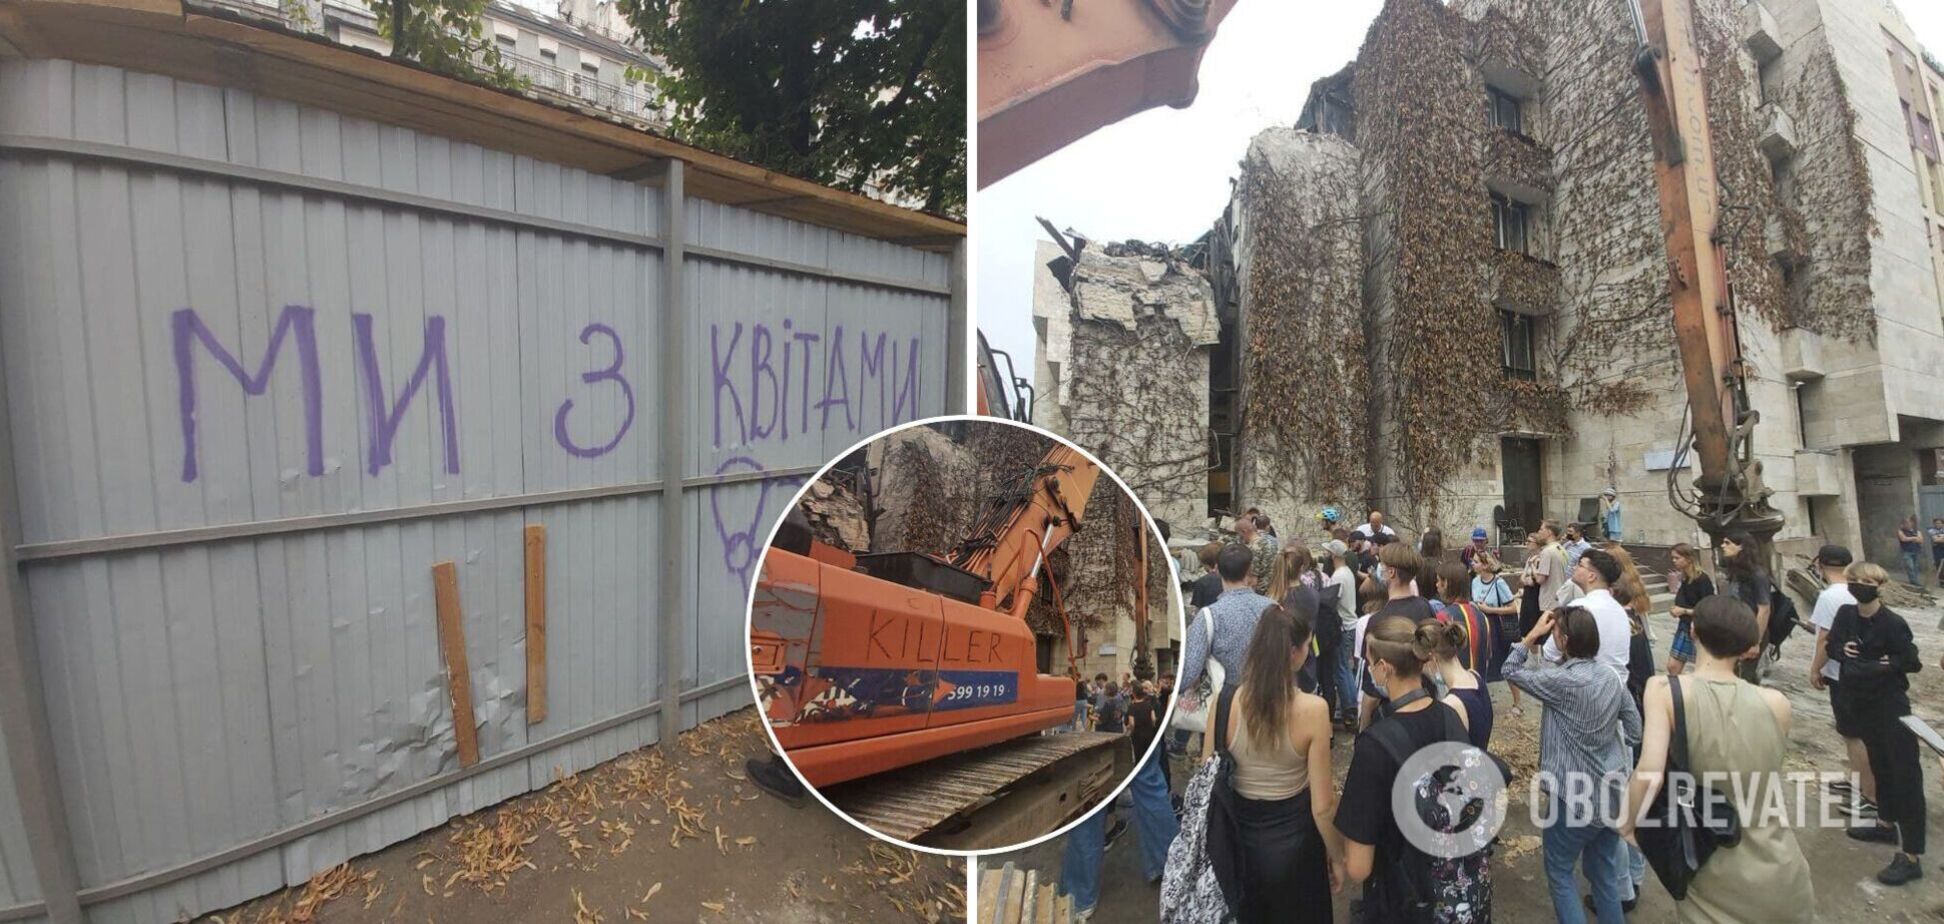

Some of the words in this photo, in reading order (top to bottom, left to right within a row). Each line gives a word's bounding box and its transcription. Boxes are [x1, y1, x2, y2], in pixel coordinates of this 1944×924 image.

[172, 304, 460, 482] МИ
[866, 609, 1003, 663] KILLER
[976, 684, 990, 698] 19
[993, 684, 1005, 697] 19
